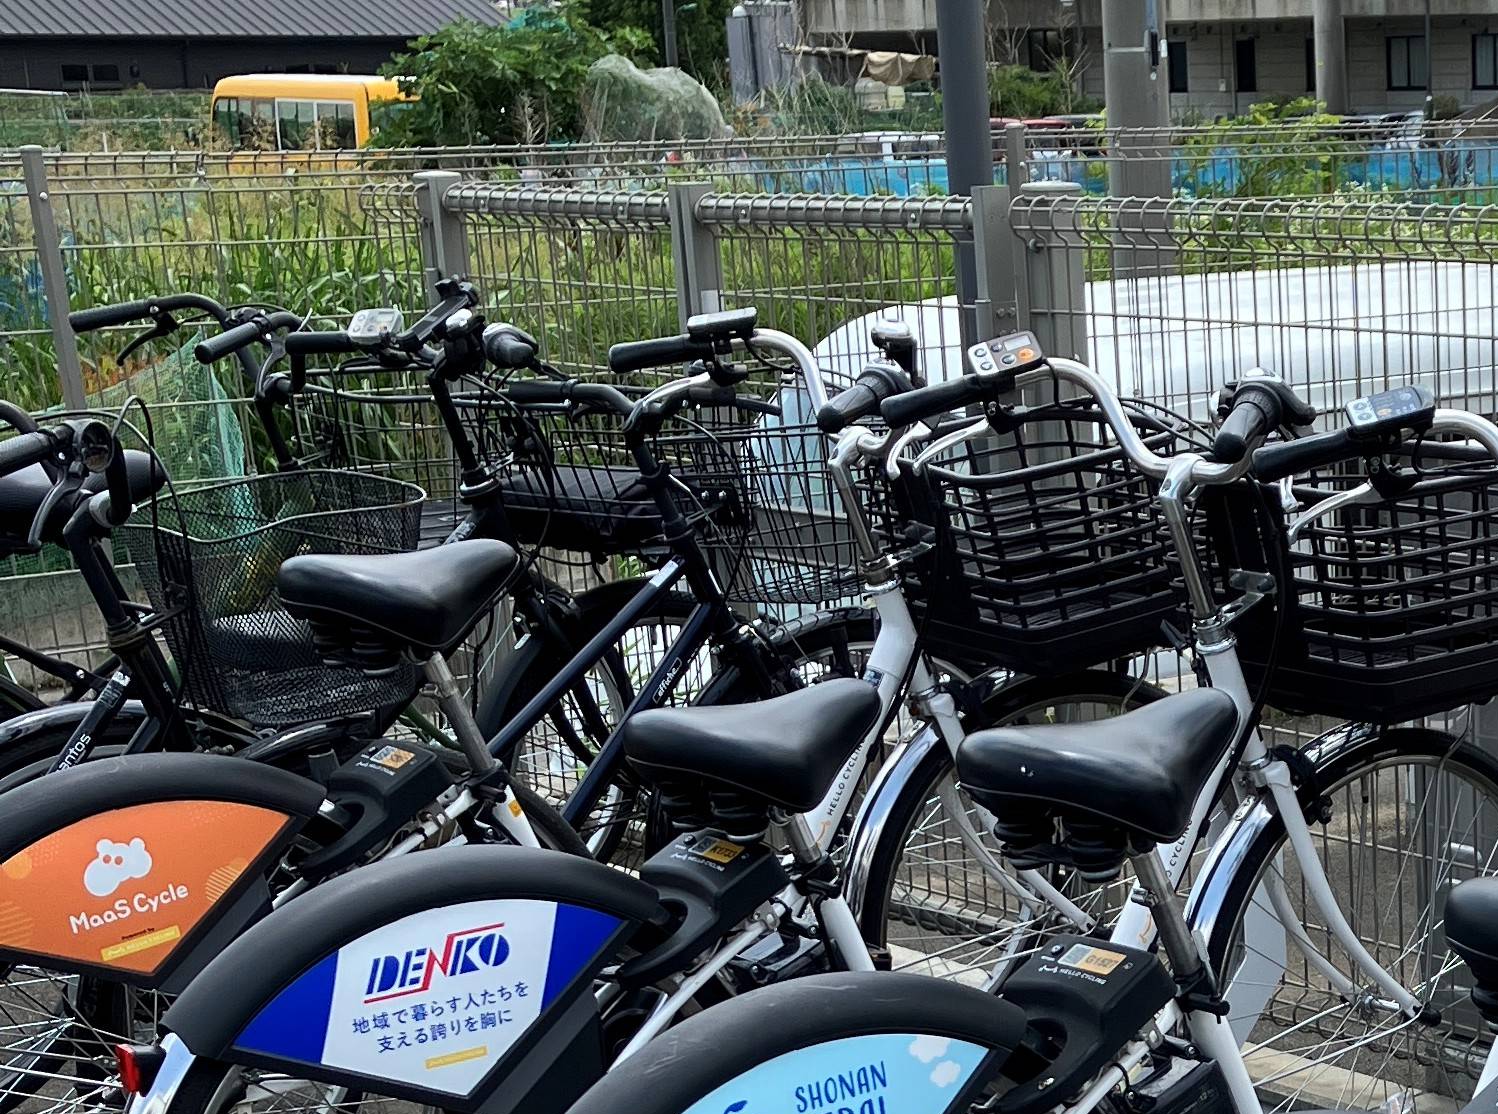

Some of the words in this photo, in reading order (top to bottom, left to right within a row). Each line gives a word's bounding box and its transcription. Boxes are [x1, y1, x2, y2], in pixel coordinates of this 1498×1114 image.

[826, 782, 845, 816] HELLO
[68, 898, 132, 935] MaaS
[132, 882, 189, 914] Cycle
[364, 926, 510, 1000] DENKO
[351, 980, 529, 1035] 地域で暮らす人たちを
[377, 1008, 513, 1054] 支える誇りを胸に
[795, 1060, 888, 1113] SHONAN
